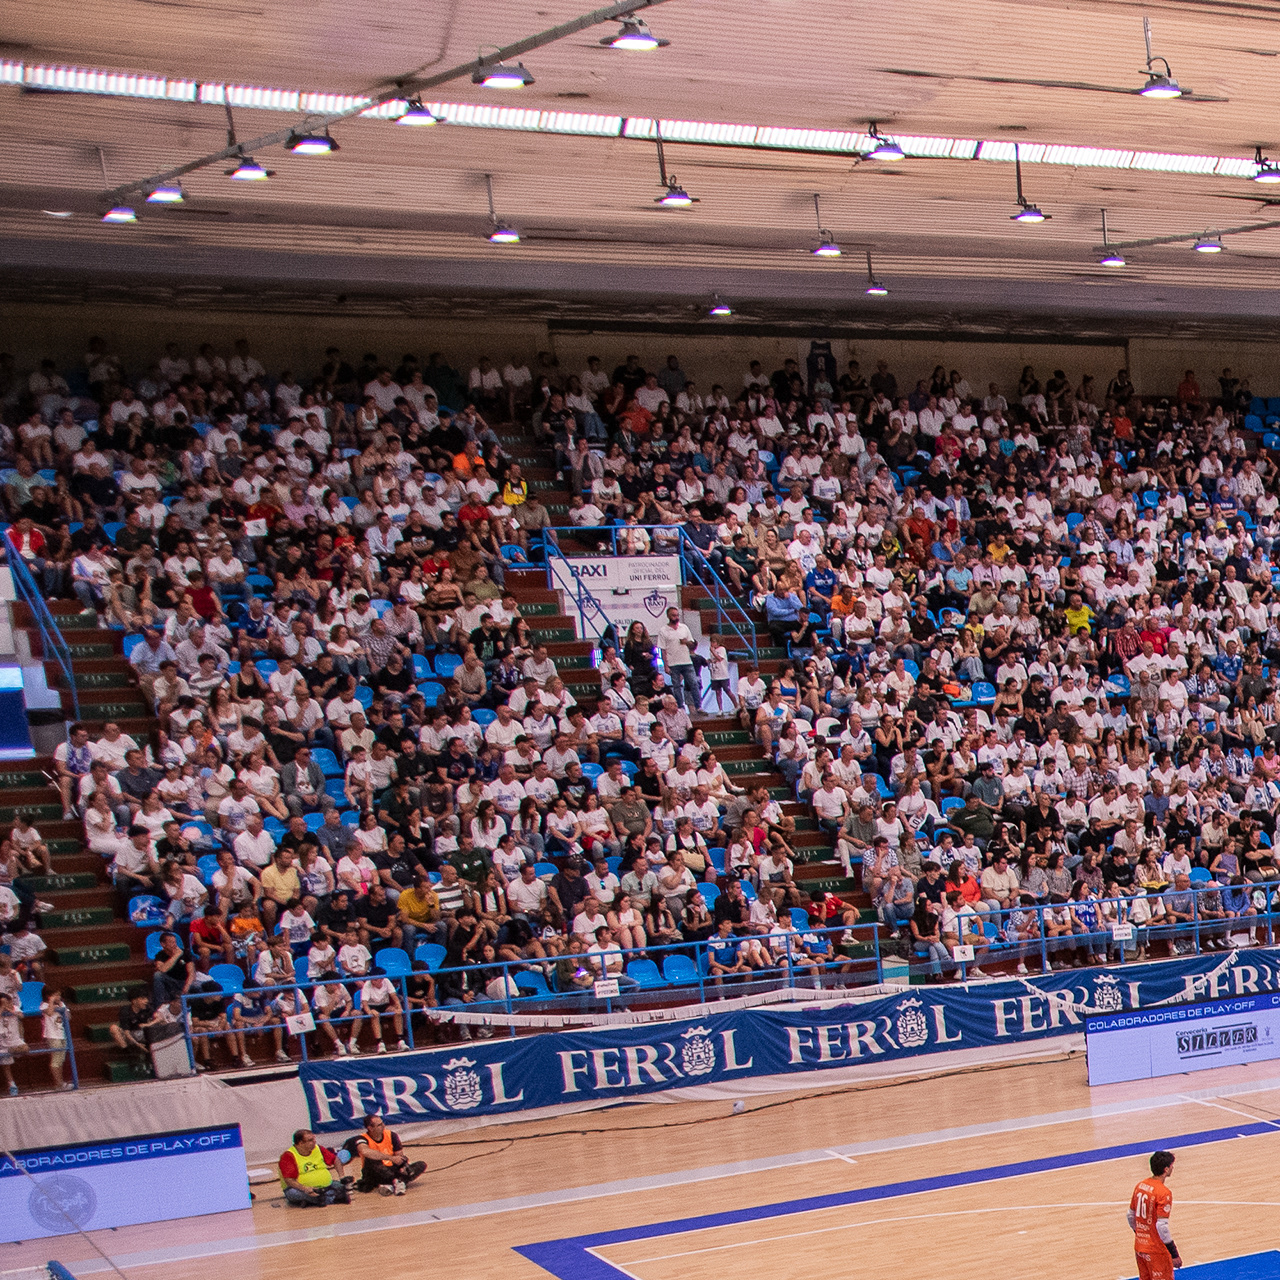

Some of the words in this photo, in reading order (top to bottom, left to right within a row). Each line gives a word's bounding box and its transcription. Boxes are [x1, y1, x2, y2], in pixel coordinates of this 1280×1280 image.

[571, 564, 607, 577] BAXI
[1088, 1011, 1186, 1031] COLABORADORES
[1187, 1007, 1201, 1018] DE
[1178, 1026, 1258, 1053] SILVER
[124, 1143, 149, 1156] DE
[1135, 1193, 1149, 1219] 16
